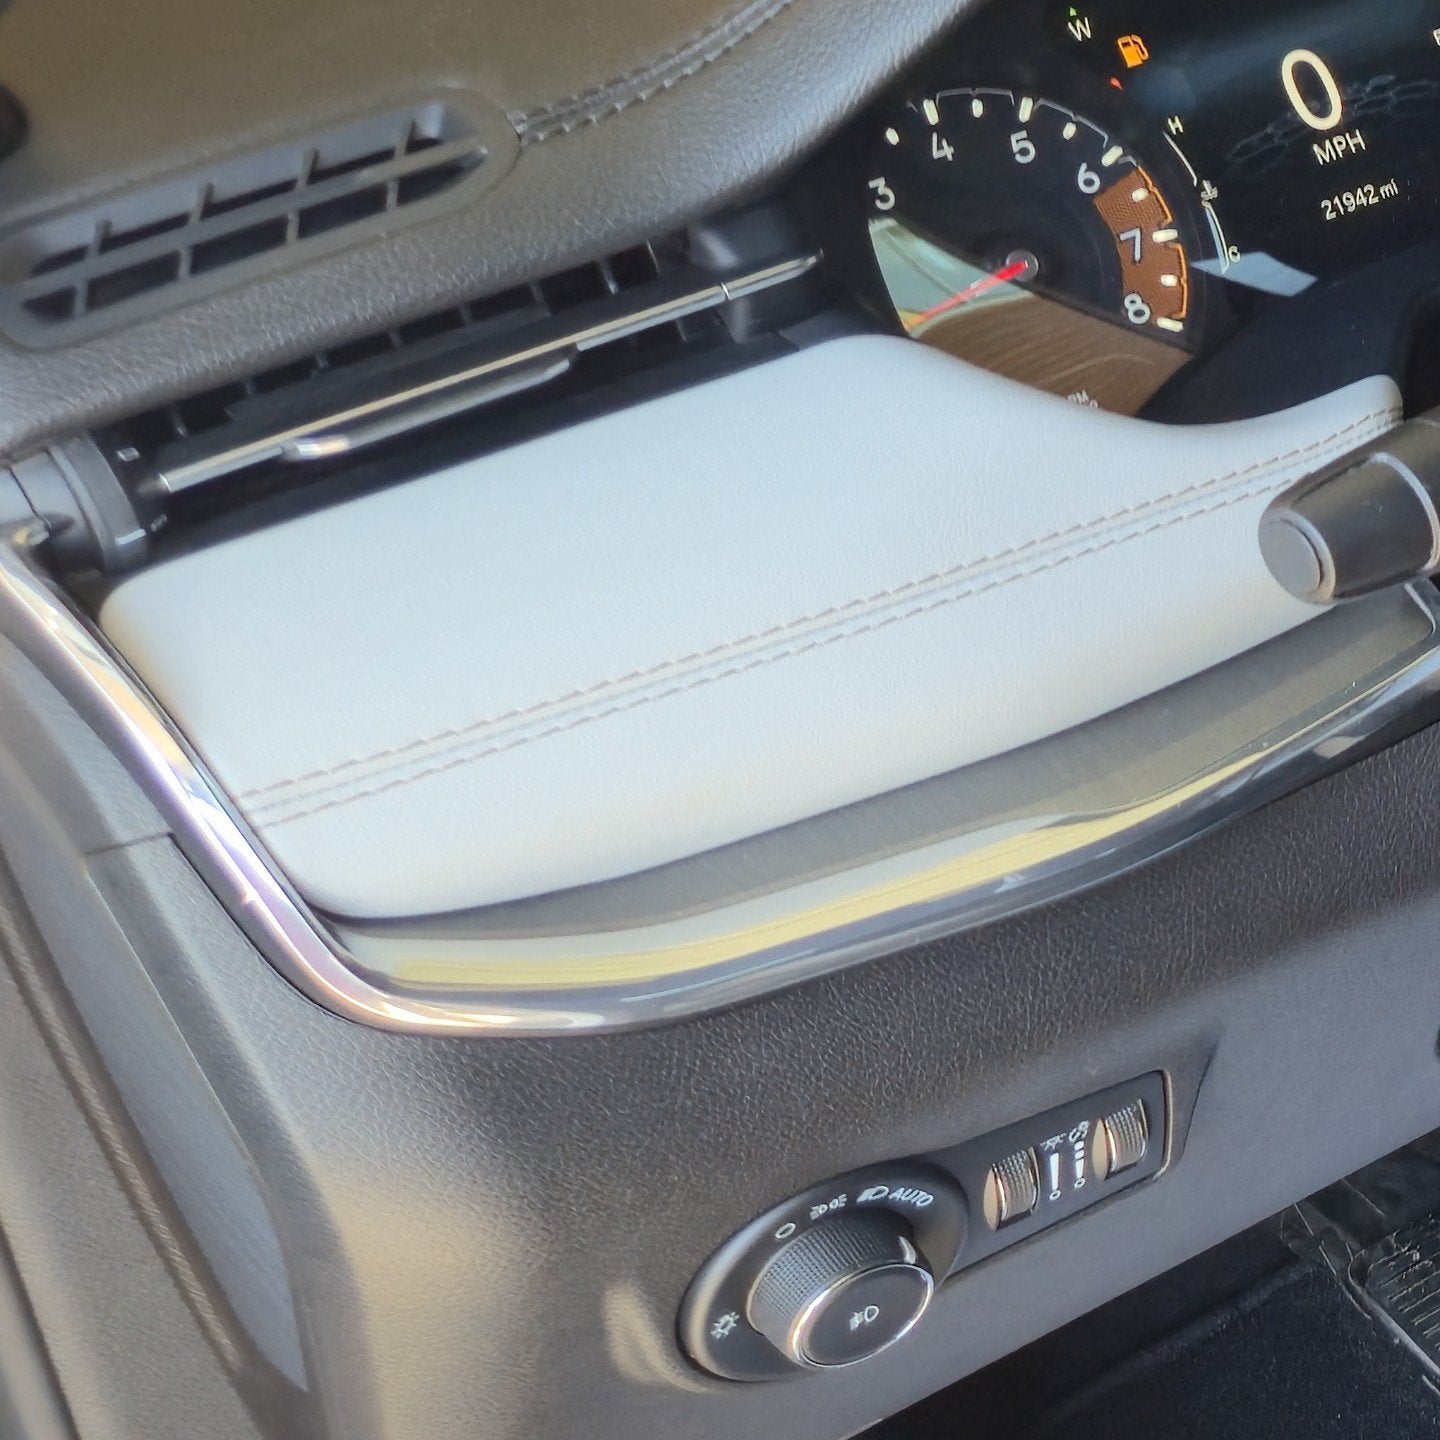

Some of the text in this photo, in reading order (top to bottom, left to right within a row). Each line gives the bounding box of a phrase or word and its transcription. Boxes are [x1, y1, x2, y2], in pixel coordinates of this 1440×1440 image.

[1067, 16, 1092, 42] W
[1280, 48, 1344, 132] 0
[1167, 115, 1185, 136] H
[931, 131, 955, 162] 4
[1010, 130, 1036, 164] 5
[1312, 129, 1367, 166] MPH
[868, 176, 896, 211] 3
[1077, 162, 1101, 195] 6
[1320, 177, 1400, 222] 21942 mi
[1119, 227, 1142, 263] 7
[1123, 292, 1152, 325] 8
[888, 1187, 935, 1208] AUTO
